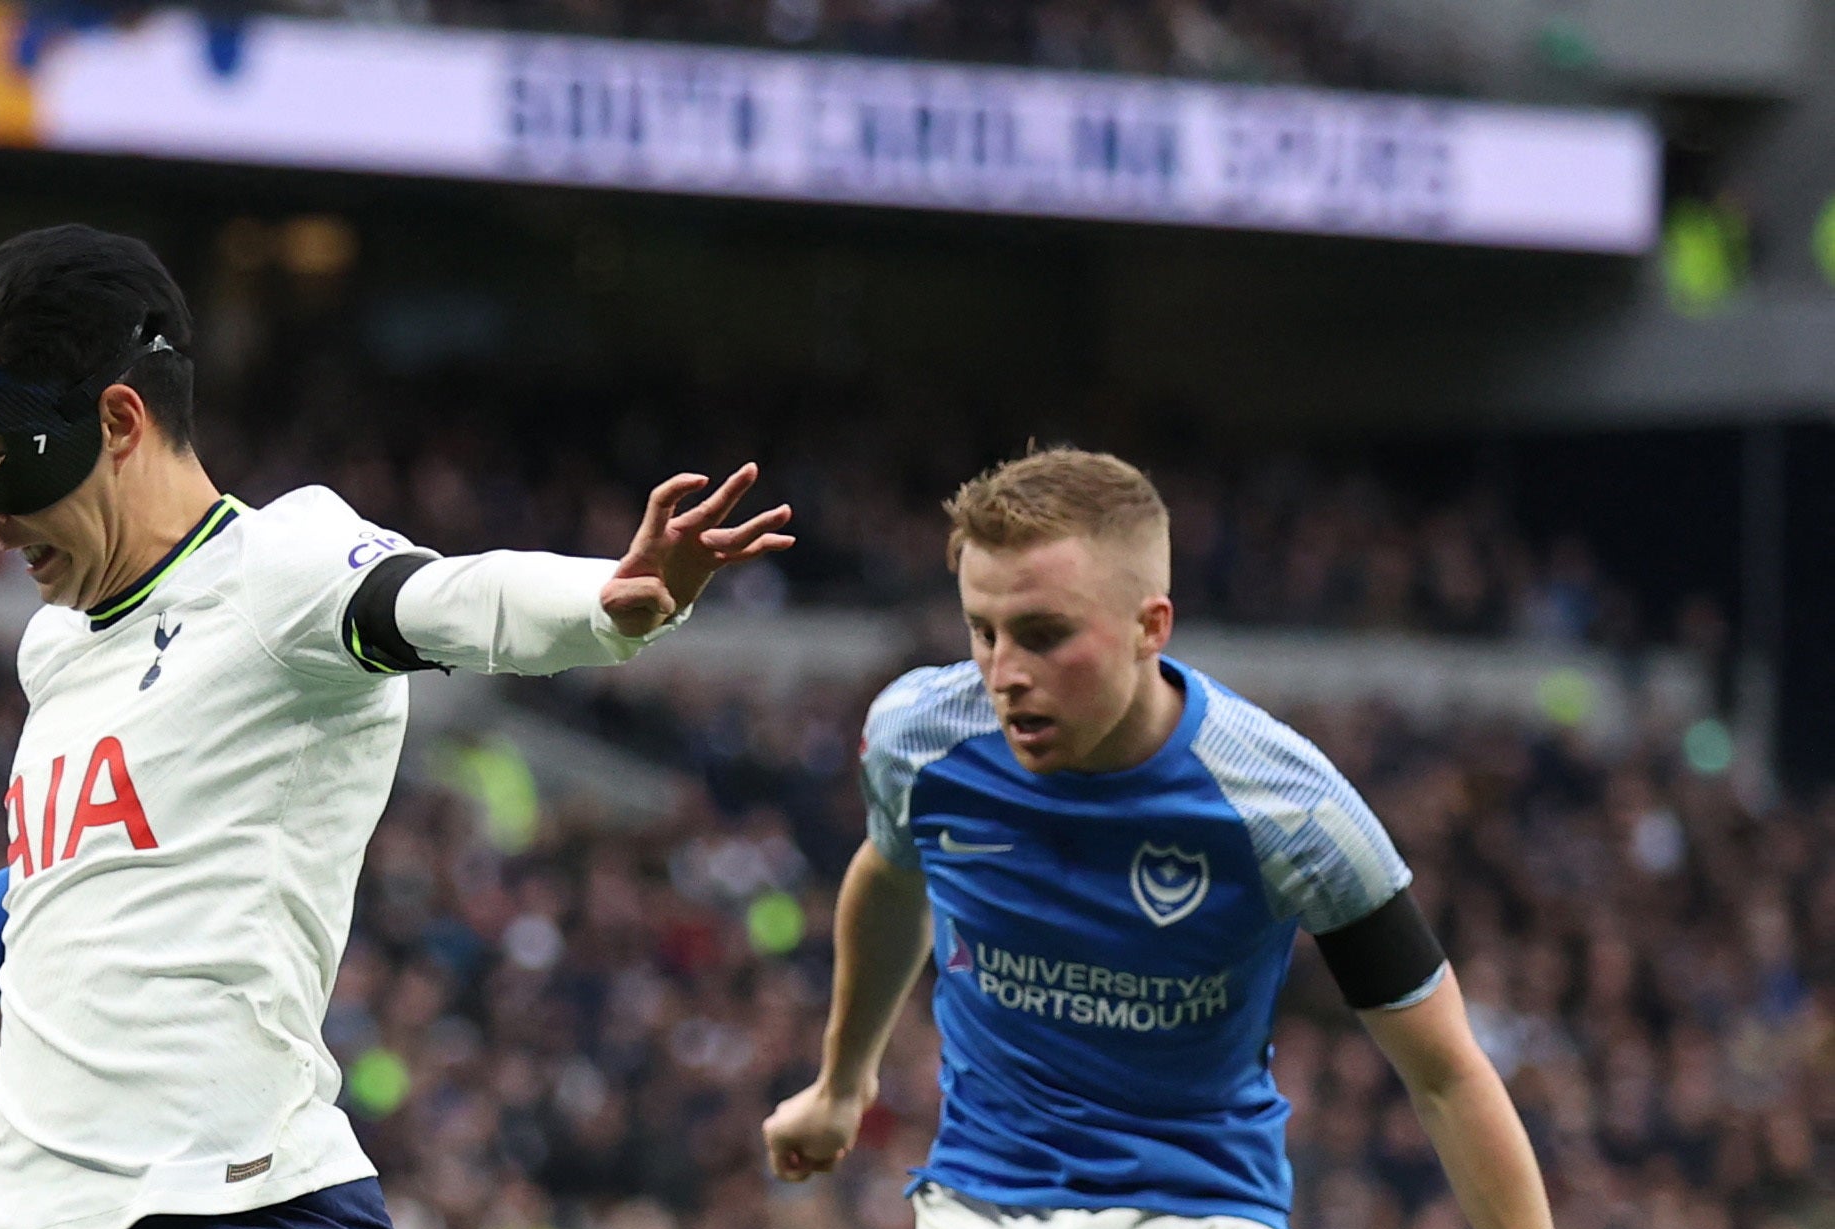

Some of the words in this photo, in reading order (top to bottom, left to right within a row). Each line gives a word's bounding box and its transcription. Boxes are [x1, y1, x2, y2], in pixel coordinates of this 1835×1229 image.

[33, 434, 47, 454] 7
[977, 943, 1199, 999] UNIVERSITY
[978, 972, 1228, 1032] PORTSMOUTH
